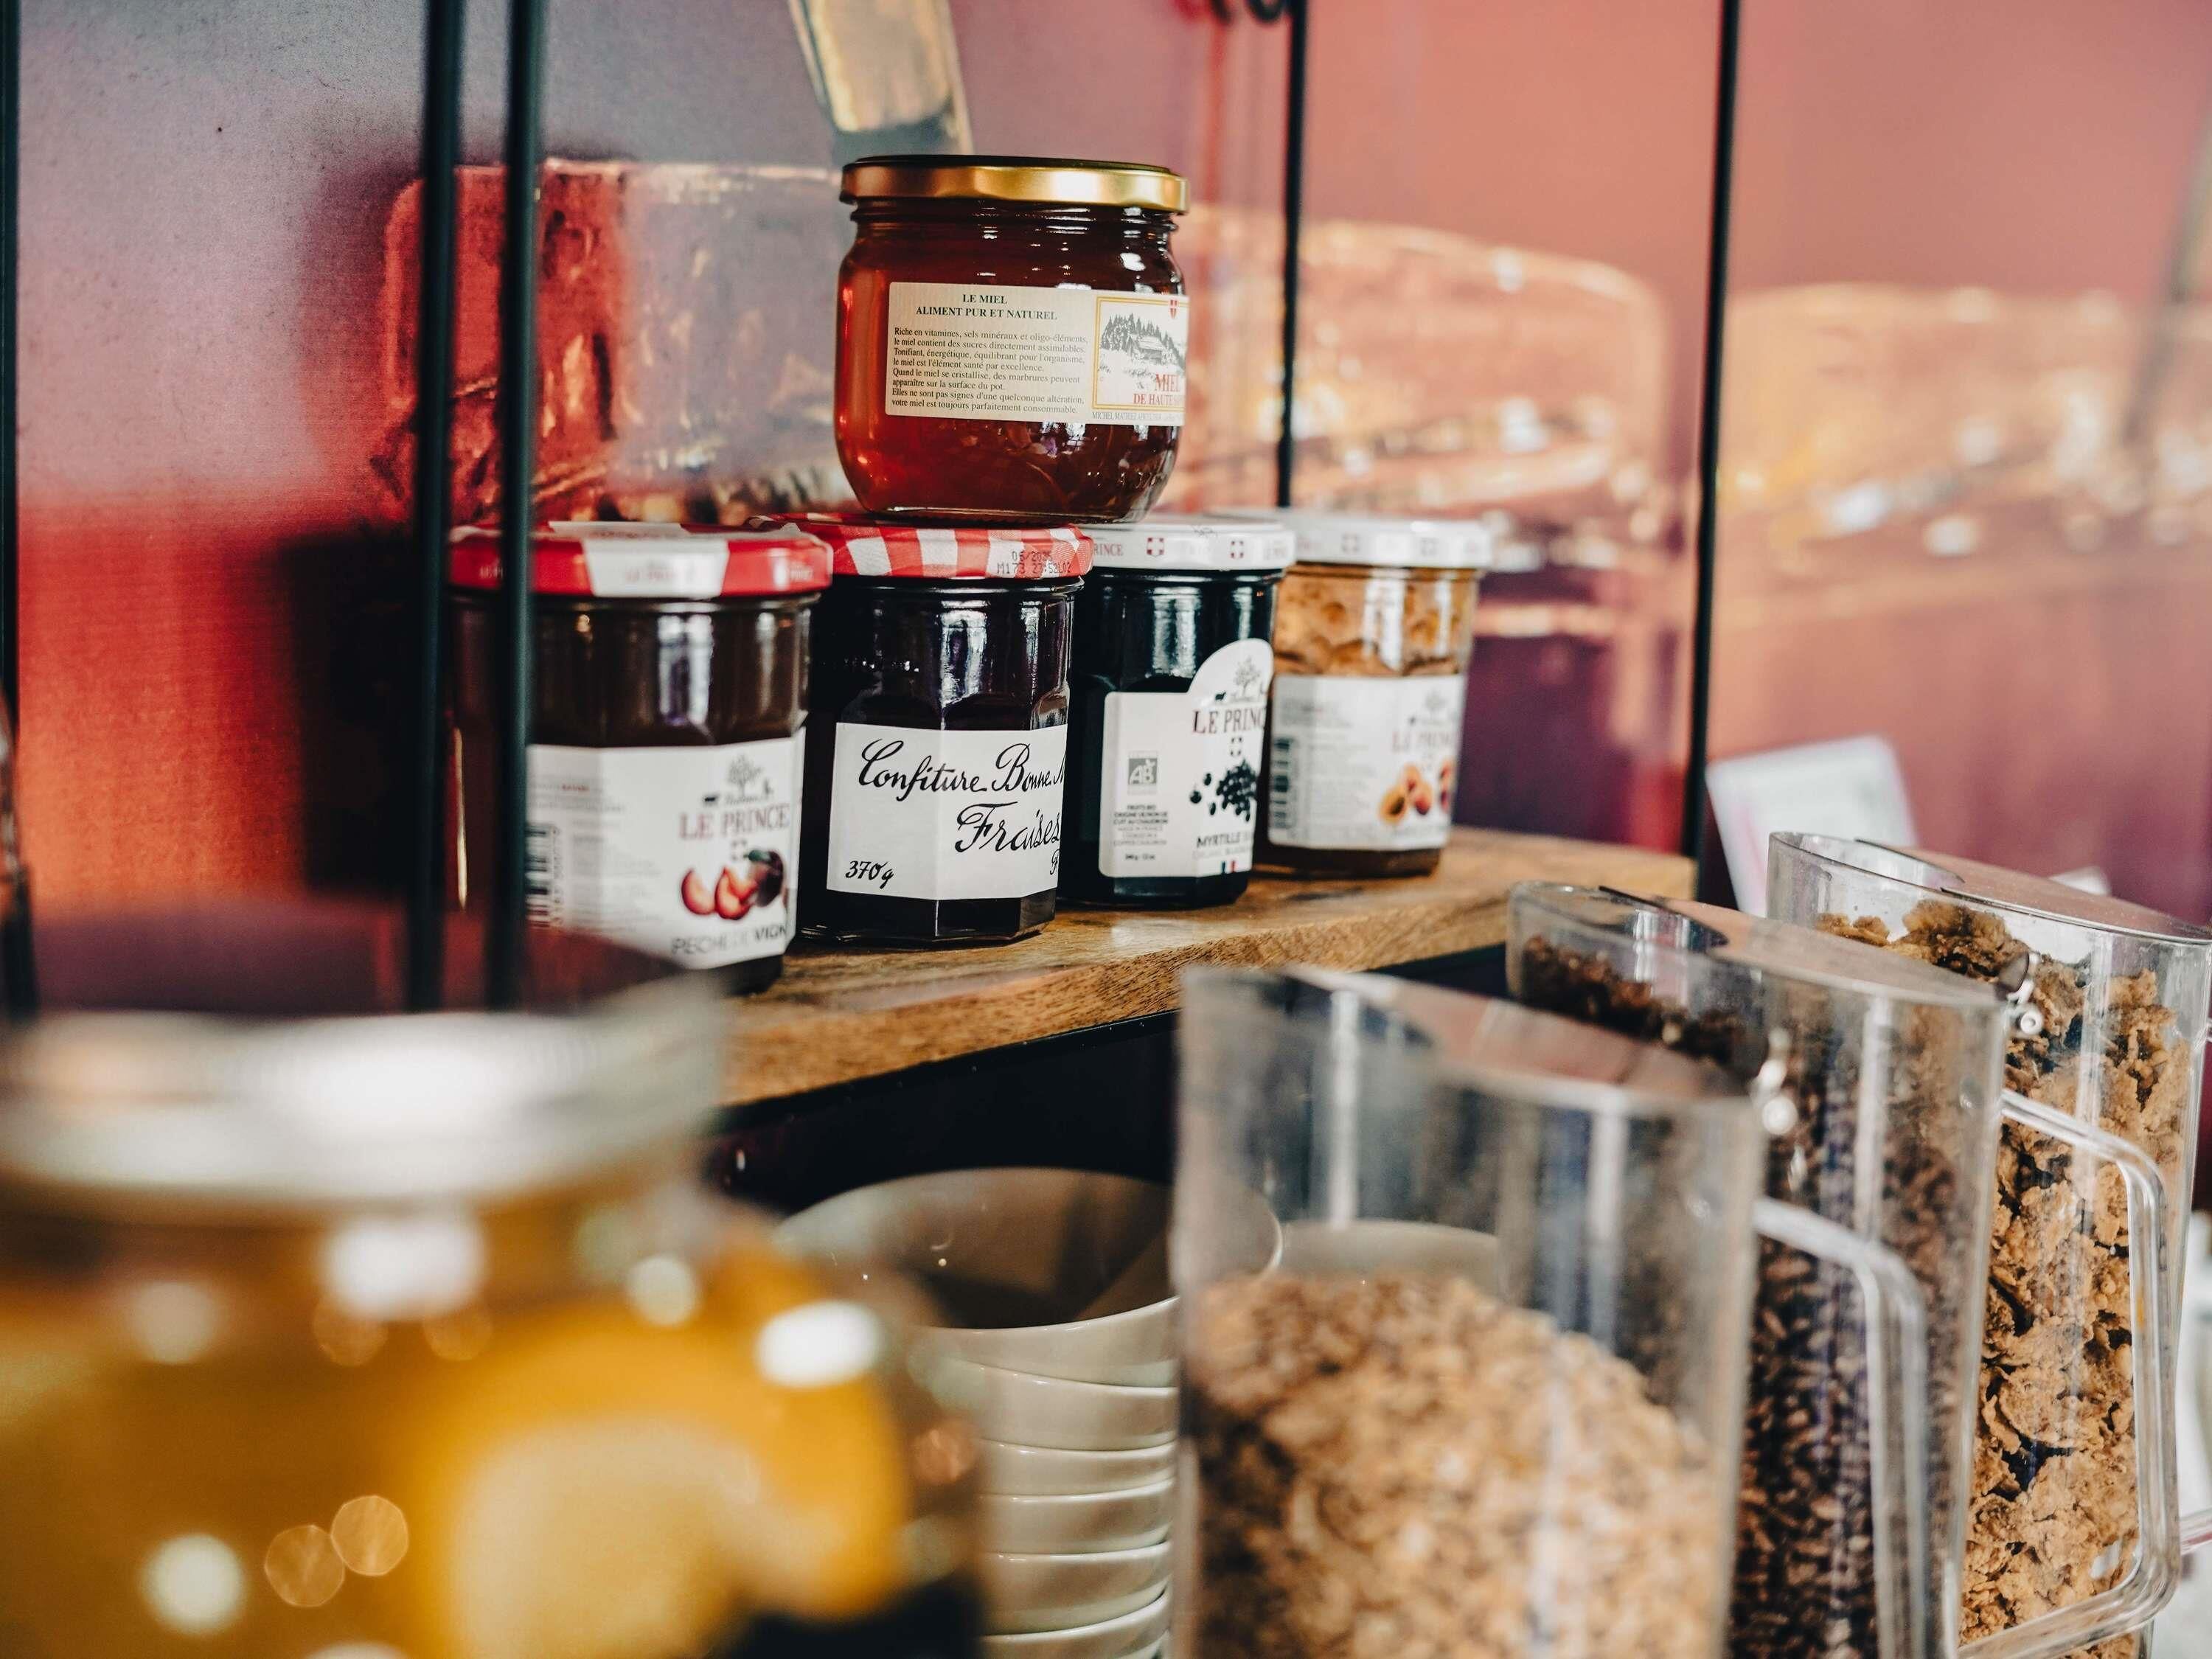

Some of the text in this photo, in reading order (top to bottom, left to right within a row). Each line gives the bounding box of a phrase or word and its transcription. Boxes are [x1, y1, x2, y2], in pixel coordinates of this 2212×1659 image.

[962, 294, 1007, 304] LE MIEL
[916, 306, 1057, 320] ALIMENT PUR ET NATUREL
[894, 327, 913, 335] Riche
[924, 330, 961, 338] vitamines,
[981, 331, 1018, 340] minéraux
[1029, 333, 1088, 344] oligo-éléments,
[901, 338, 916, 346] miel
[917, 339, 945, 347] contient
[947, 339, 960, 347] des
[989, 341, 1035, 350] directement
[1037, 344, 1086, 353] assimilables.
[894, 347, 1085, 364] Tonifiant, énergétique, équilibrant pour l'organisme,
[893, 358, 899, 366] le
[901, 358, 915, 366] miel
[928, 359, 961, 368] l'élément
[964, 361, 984, 369] santé
[986, 363, 998, 371] par
[1001, 364, 1045, 372] excellence.
[892, 367, 914, 378] Quand
[916, 369, 922, 377] le
[924, 369, 939, 378] miel
[951, 371, 991, 380] cristallise,
[992, 372, 1006, 380] des
[1009, 374, 1048, 382] marbrures
[1050, 375, 1079, 384] peuvent
[892, 378, 924, 388] apparaître
[990, 383, 1005, 392] pot.
[891, 388, 908, 397] Elles
[950, 392, 974, 400] signes
[976, 392, 998, 400] d'une
[999, 394, 1045, 403] quelconque
[1046, 394, 1085, 404] altération,
[1134, 393, 1145, 405] DE
[939, 401, 969, 410] toujours
[971, 403, 1020, 412] parfaitement
[1023, 405, 1078, 413] consommable.
[1092, 411, 1113, 420] MICHEL
[1193, 709, 1218, 734] LE
[858, 739, 987, 801] Confiture
[992, 743, 1052, 792] Bonne
[679, 803, 790, 841] LE PRINCE
[955, 801, 1060, 852] Fraises
